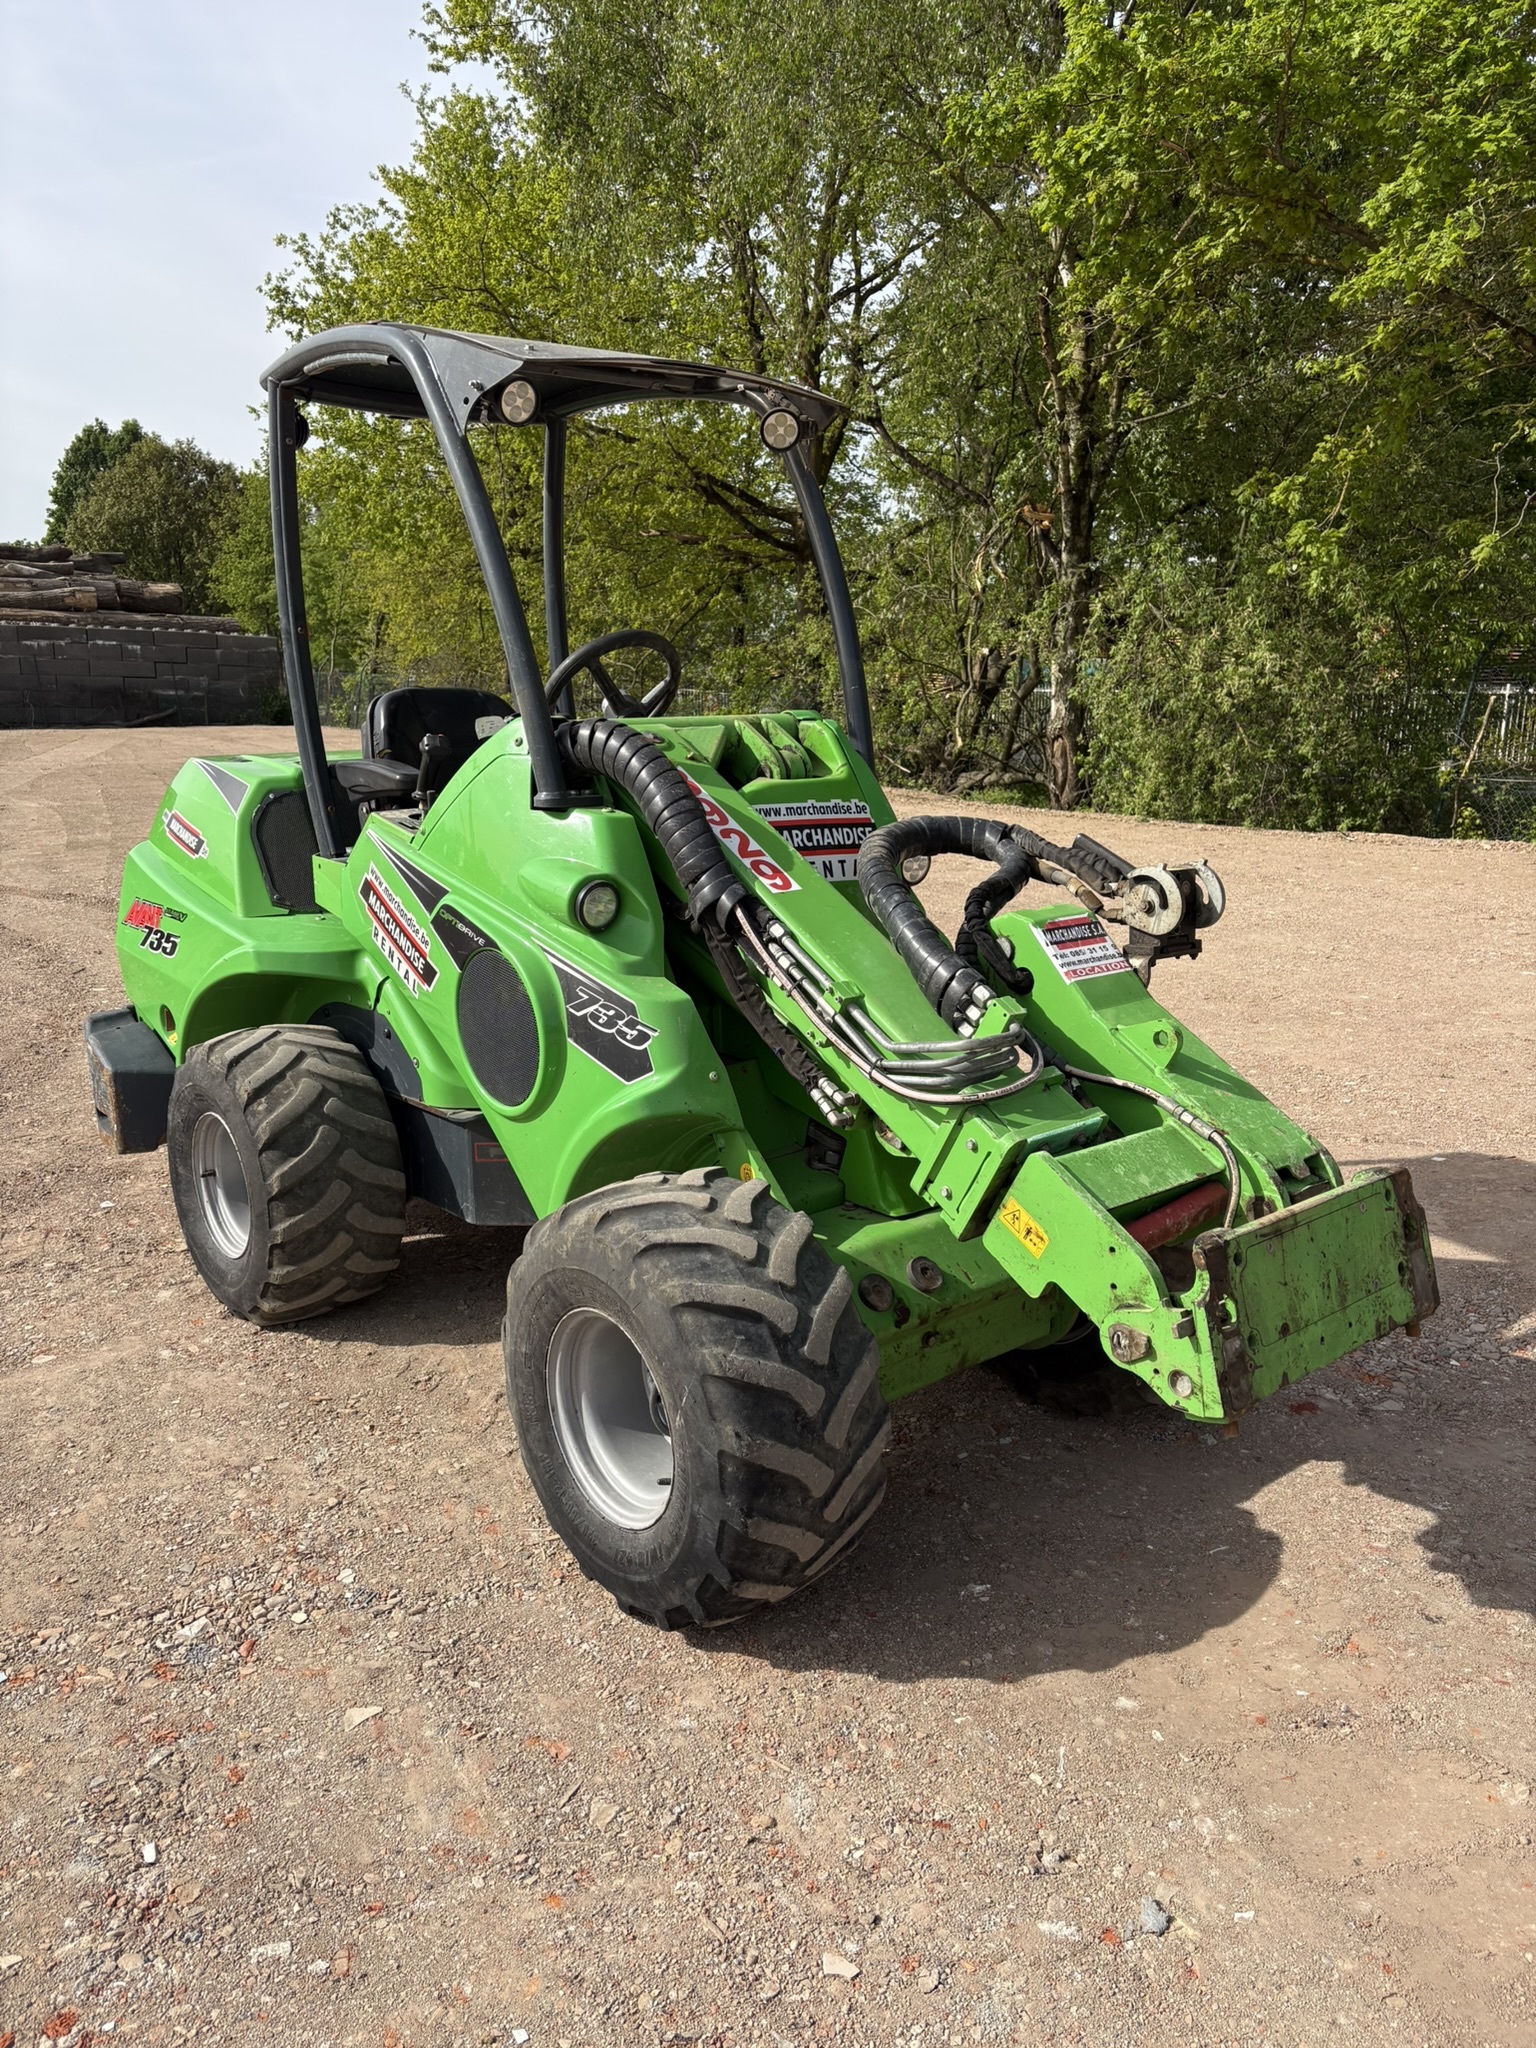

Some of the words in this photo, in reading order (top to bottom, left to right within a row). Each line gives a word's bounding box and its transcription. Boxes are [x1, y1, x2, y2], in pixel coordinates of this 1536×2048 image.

[783, 827, 873, 848] ARCHANDIS
[370, 865, 430, 950] www.marchandise.be
[139, 926, 181, 957] 735
[369, 890, 426, 975] MARCHANDISE
[1045, 925, 1091, 942] MARCHANDISE
[373, 924, 418, 996] RENTAL
[1059, 951, 1124, 969] www.marchandise.b
[1087, 947, 1098, 955] 31
[1069, 960, 1130, 978] LOCATION
[566, 985, 661, 1051] 735
